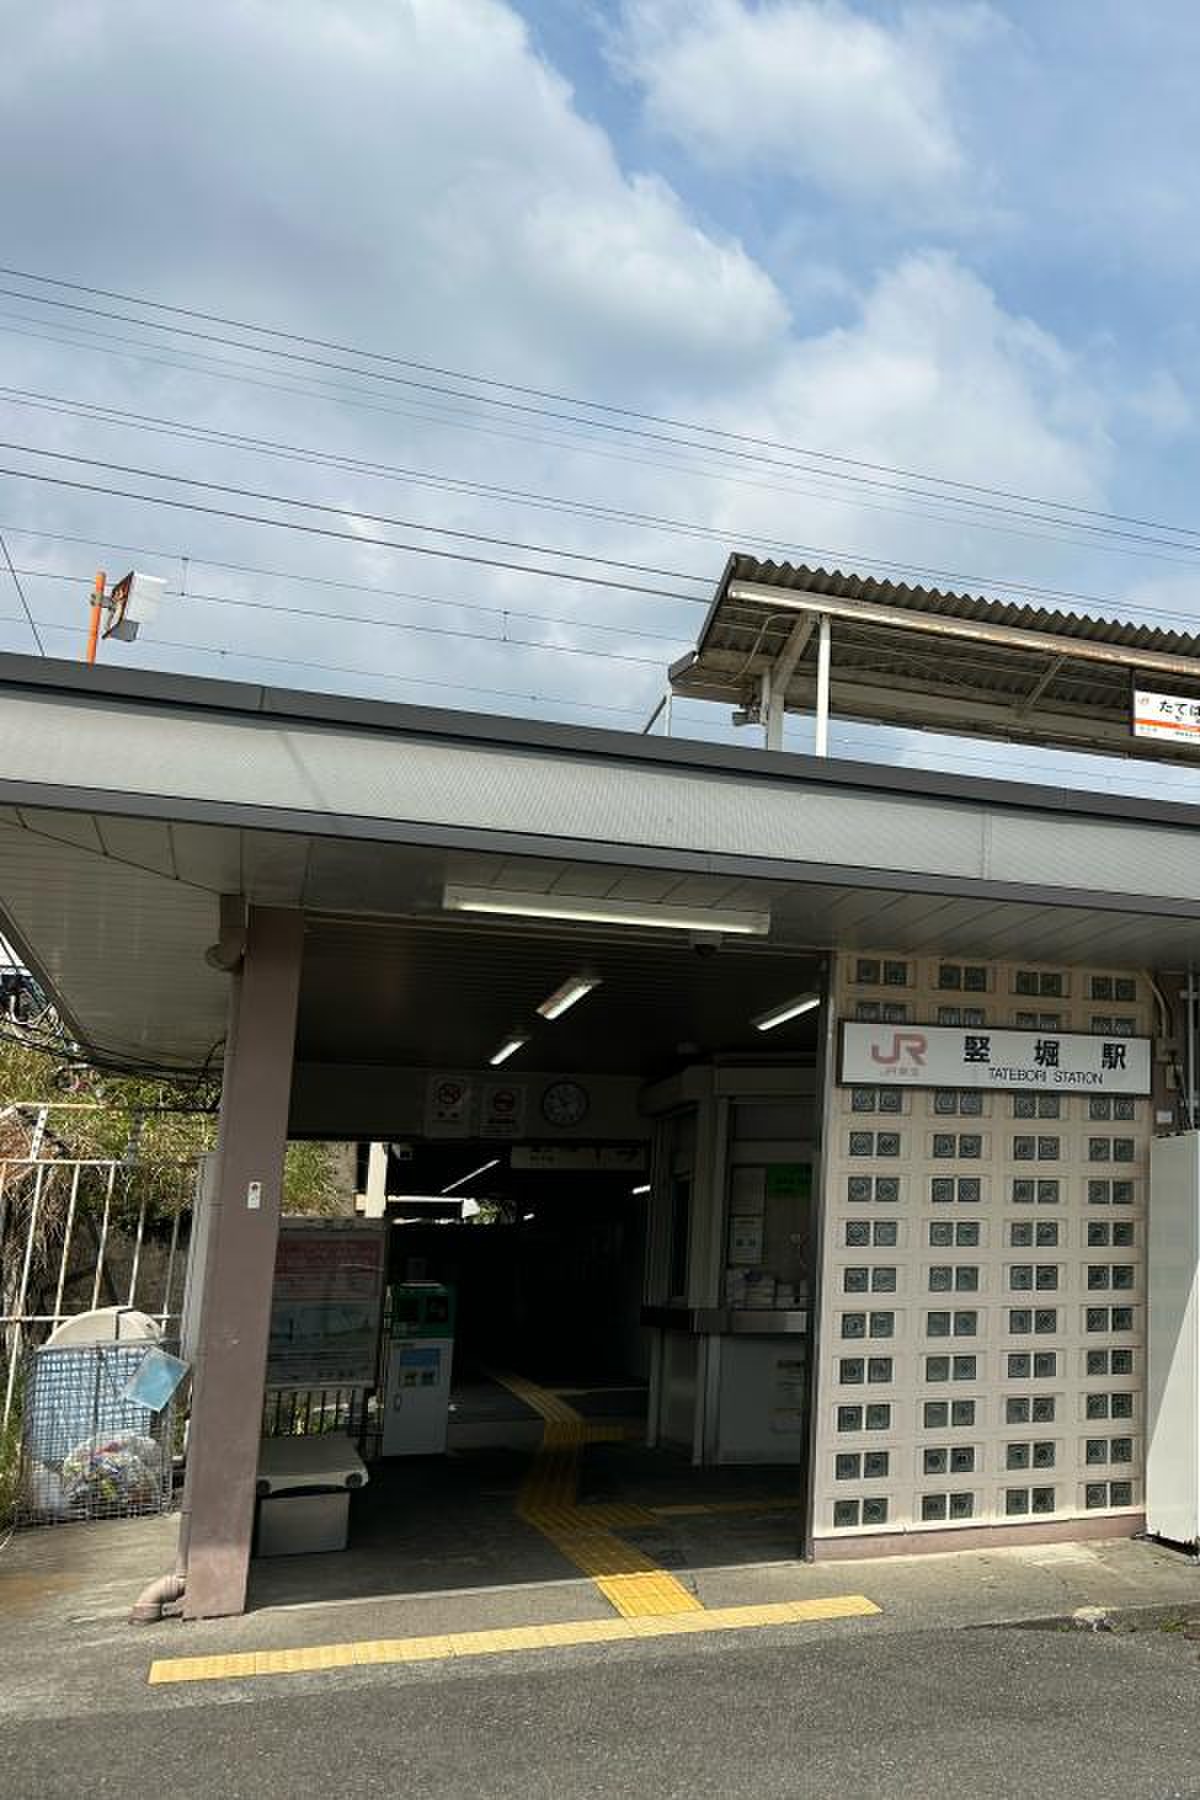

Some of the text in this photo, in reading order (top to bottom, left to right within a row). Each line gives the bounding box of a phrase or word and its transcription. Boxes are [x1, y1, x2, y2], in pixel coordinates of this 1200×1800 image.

[871, 1033, 927, 1066] JR
[964, 1035, 1127, 1070] 竪堀駅
[988, 1067, 1104, 1086] TATEBORI STATION
